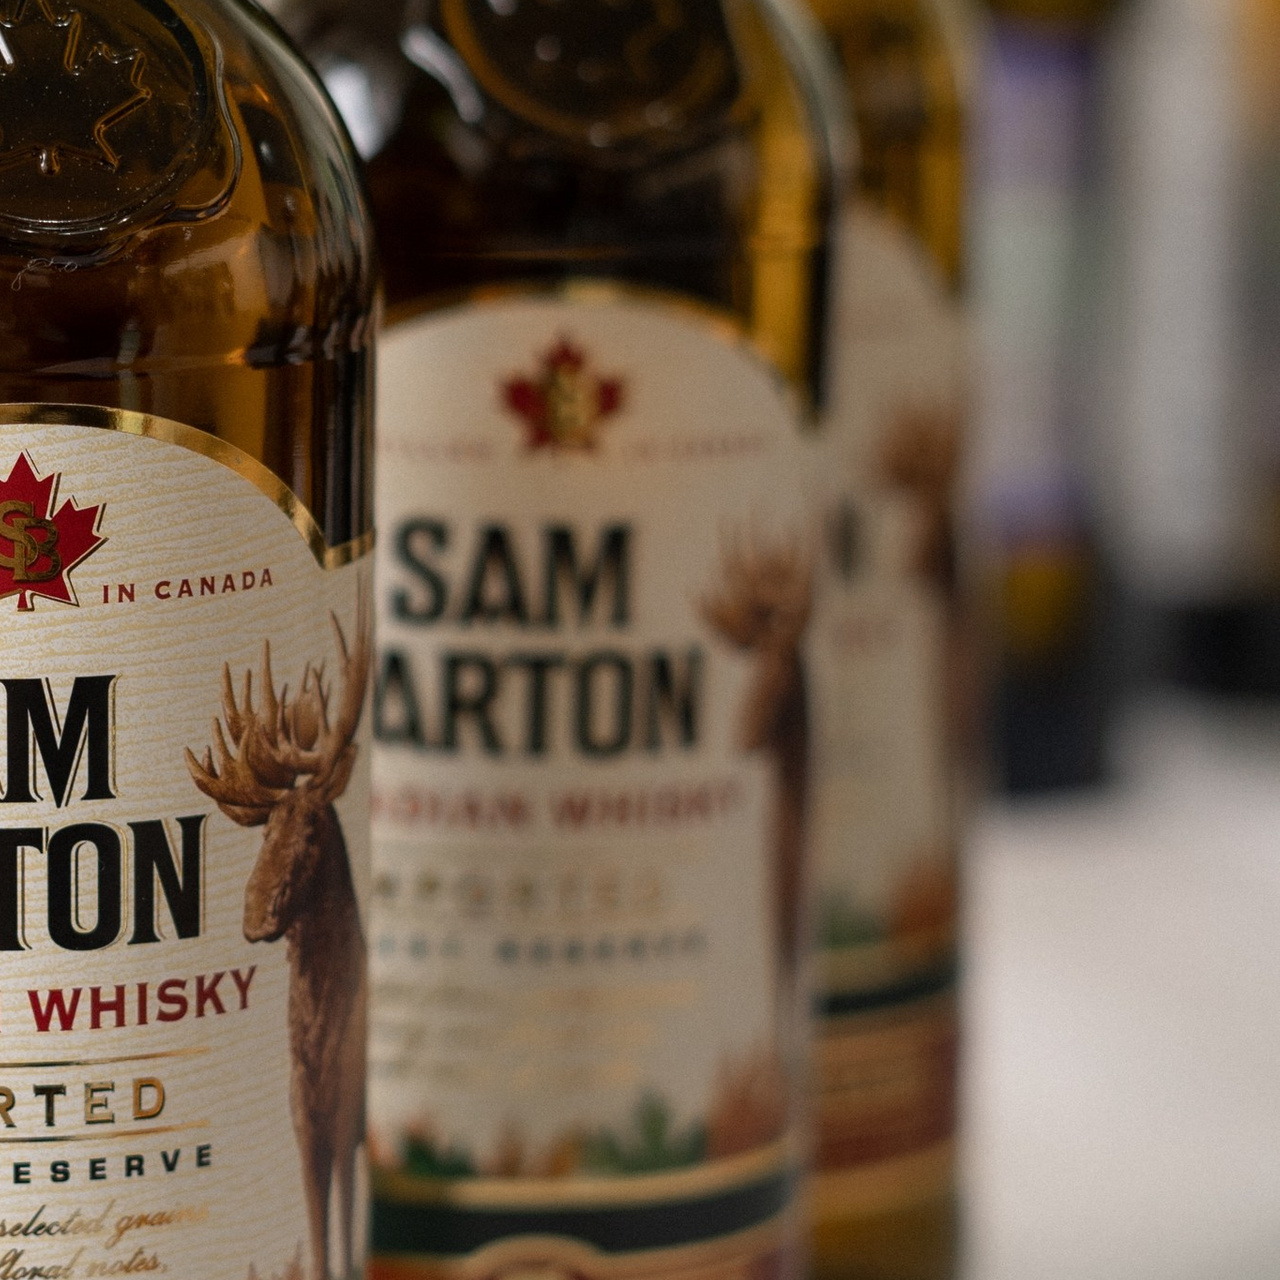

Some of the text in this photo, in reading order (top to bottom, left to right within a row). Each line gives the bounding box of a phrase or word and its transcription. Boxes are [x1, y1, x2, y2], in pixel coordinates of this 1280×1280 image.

[103, 583, 136, 604] IN
[154, 568, 273, 600] CANADA
[390, 511, 633, 629] SAM
[370, 641, 706, 760] ARTON
[27, 965, 257, 1033] WHISKY
